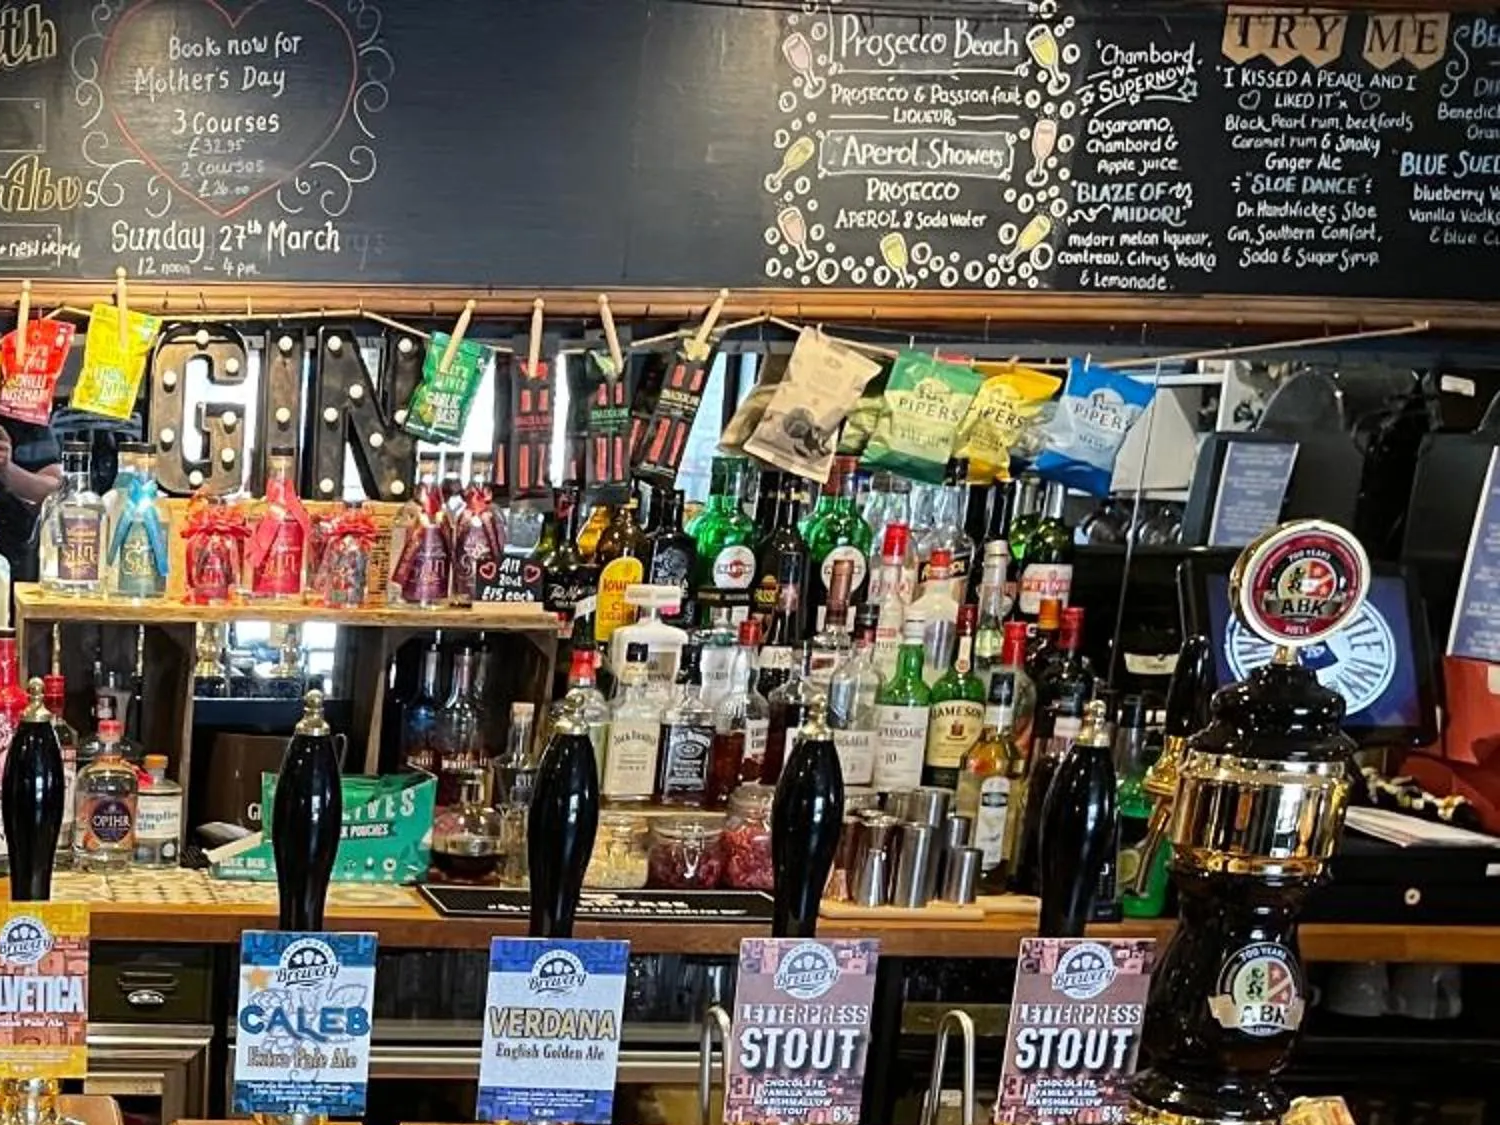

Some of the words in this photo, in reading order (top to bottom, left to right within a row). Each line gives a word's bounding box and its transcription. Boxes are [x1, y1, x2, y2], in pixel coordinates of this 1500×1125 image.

[169, 36, 221, 60] Book
[227, 36, 268, 56] now
[275, 31, 302, 59] for
[841, 13, 948, 67] Prosecco
[953, 17, 1020, 60] Beach
[1231, 13, 1342, 52] TRY
[1366, 18, 1441, 56] ME
[134, 66, 230, 103] Mother's
[241, 65, 286, 99] Day
[1240, 67, 1299, 89] KISSED
[1300, 70, 1313, 89] A
[1316, 69, 1365, 93] PEARL
[1369, 73, 1404, 90] AND
[1404, 74, 1418, 92] I
[830, 83, 909, 106] PROSECCO
[913, 85, 926, 104] &
[1274, 92, 1315, 109] LIKED
[172, 108, 186, 135] 3
[193, 111, 280, 135] Courses
[1224, 113, 1272, 133] Black
[1271, 113, 1307, 130] Pearl
[187, 137, 245, 158] £32.95
[1163, 135, 1179, 152] &
[1230, 133, 1286, 149] Caramel
[1288, 134, 1318, 149] rum
[1334, 133, 1381, 158] Smoky
[180, 162, 191, 179] 2
[1097, 157, 1136, 176] Apple
[1137, 157, 1179, 177] juice
[1264, 151, 1313, 174] Ginger
[1316, 153, 1343, 172] Ale
[865, 176, 961, 207] PROSECCO
[1139, 182, 1168, 202] OF
[1413, 181, 1485, 206] blueberry
[833, 207, 901, 229] APEROL
[1341, 200, 1378, 222] Sloe
[1408, 207, 1456, 223] Vanilla
[111, 219, 206, 264] Sunday
[267, 219, 341, 257] March
[1119, 229, 1160, 247] melon
[1254, 223, 1315, 246] Southern
[1443, 229, 1477, 245] blue
[137, 255, 157, 277] 12
[160, 261, 192, 275] noon
[222, 257, 235, 276] 4
[1239, 247, 1278, 268] Soda
[1295, 248, 1340, 268] Sugar
[1338, 248, 1381, 273] Syrup
[1079, 268, 1091, 287] &
[150, 320, 428, 502] GIN
[899, 397, 961, 423] PIPERS
[1073, 402, 1132, 430] PIPERS
[276, 963, 341, 984] Brewery
[239, 1004, 371, 1044] CALEB
[488, 1006, 619, 1041] VERDANA
[739, 1003, 869, 1025] LETTERPRESS
[1016, 1003, 1143, 1025] LETTERPRESS
[329, 1047, 358, 1069] Ale
[495, 1042, 540, 1062] English
[542, 1043, 583, 1060] Golden
[585, 1045, 605, 1061] Ale
[739, 1026, 861, 1070] STOUT
[1015, 1026, 1134, 1070] STOUT
[832, 1106, 854, 1123] 6%
